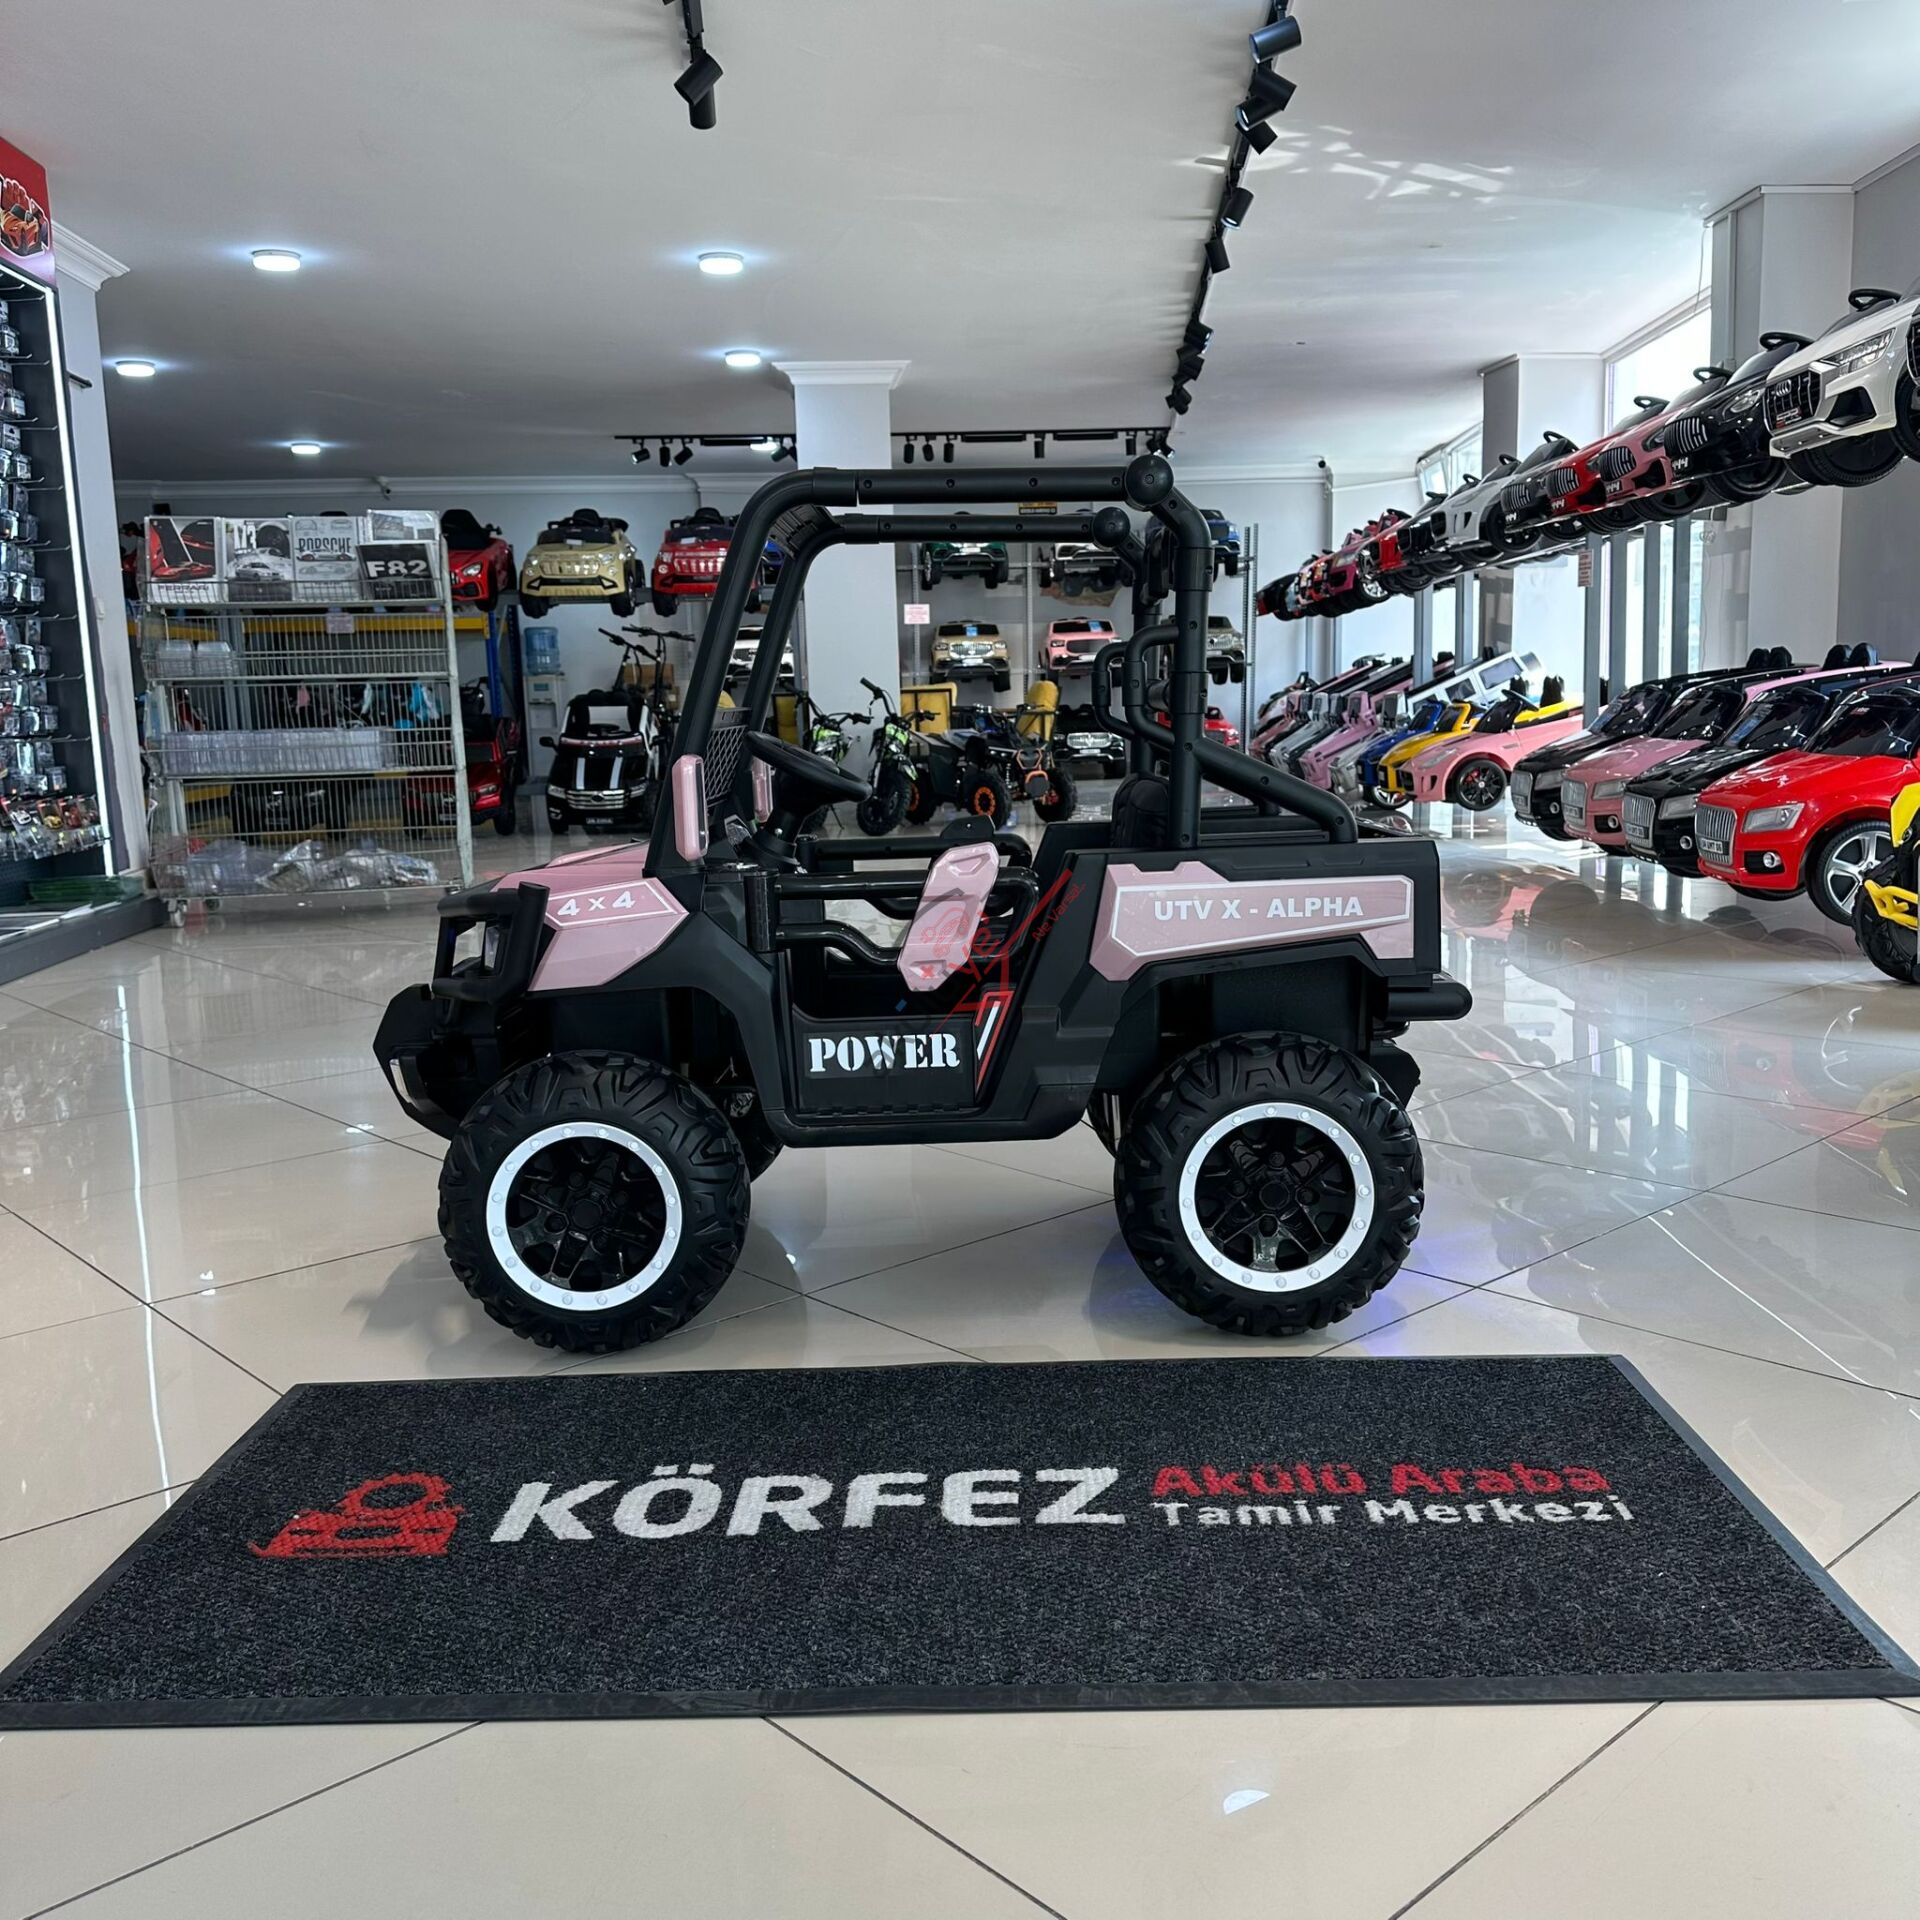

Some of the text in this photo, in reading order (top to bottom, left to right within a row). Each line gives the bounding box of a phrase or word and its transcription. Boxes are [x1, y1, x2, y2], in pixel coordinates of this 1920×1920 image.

[366, 560, 430, 578] F82
[1153, 899, 1214, 921] UTV
[1220, 898, 1242, 919] X
[1266, 897, 1364, 919] ALPHA
[808, 1032, 961, 1073] POWER
[1152, 1460, 1612, 1496] Akülü Araba
[490, 1463, 1127, 1543] KÖRFEZ
[1150, 1495, 1637, 1527] Tamir Merkezi
